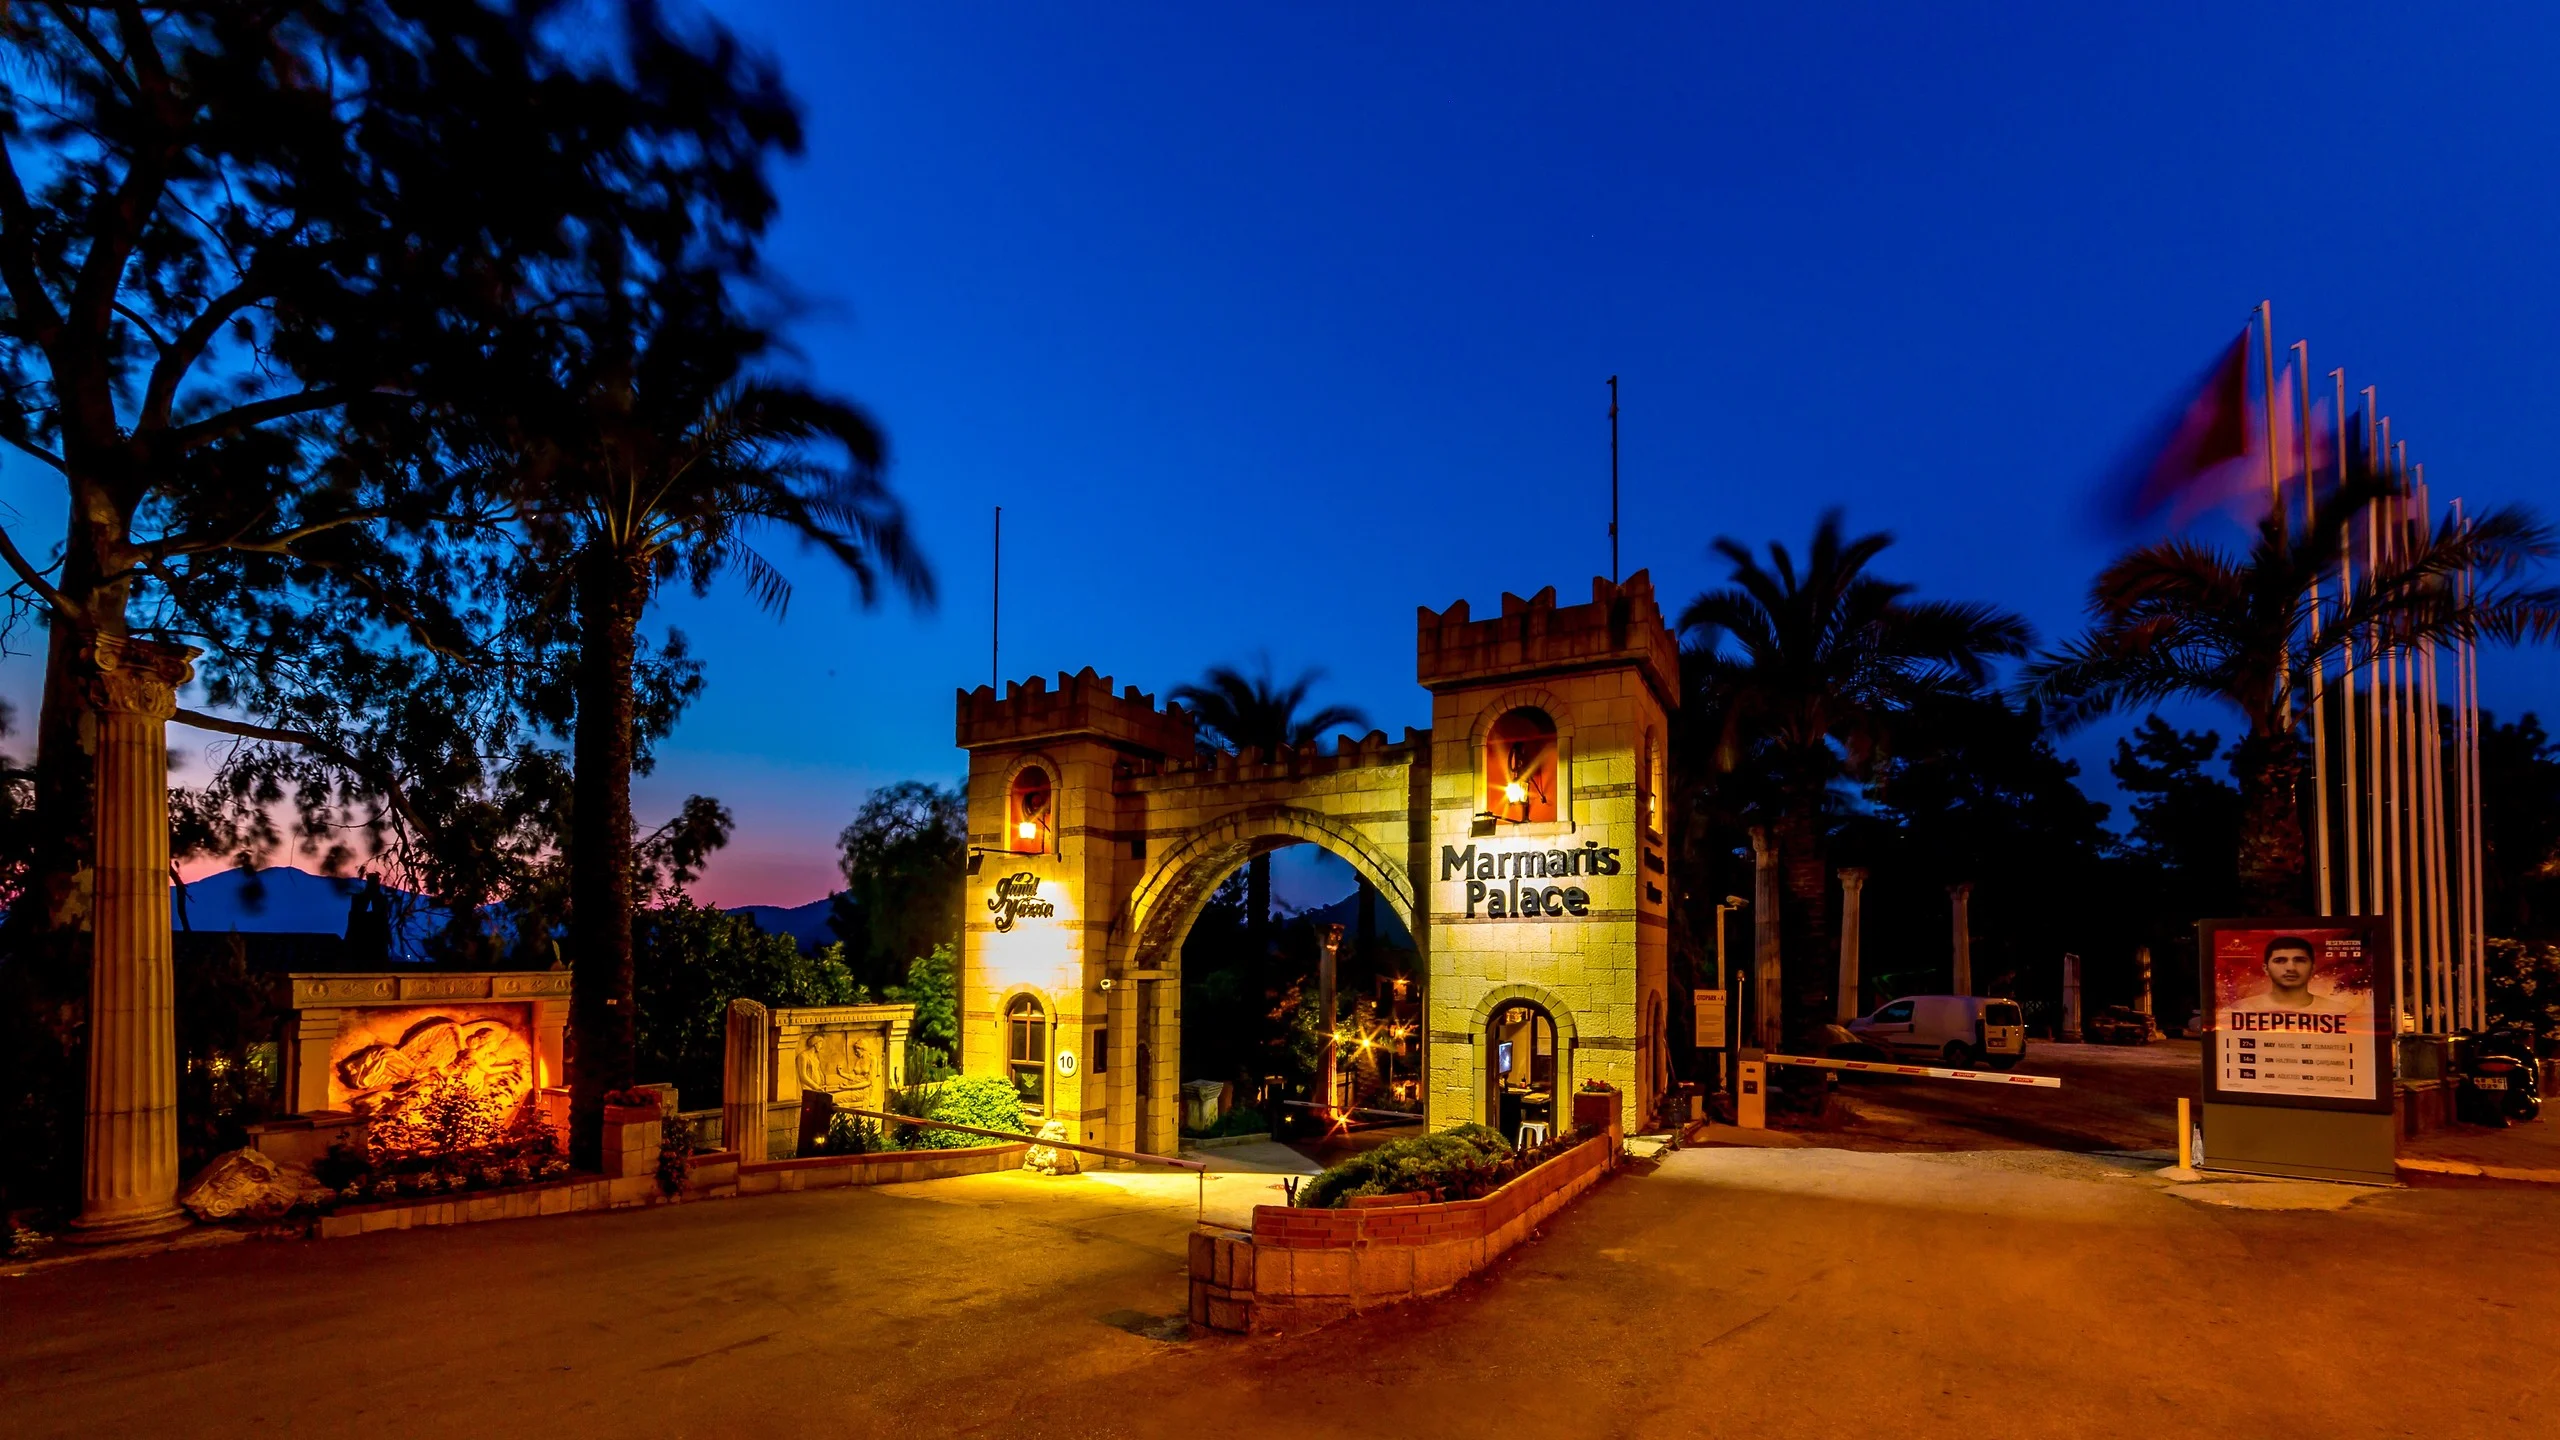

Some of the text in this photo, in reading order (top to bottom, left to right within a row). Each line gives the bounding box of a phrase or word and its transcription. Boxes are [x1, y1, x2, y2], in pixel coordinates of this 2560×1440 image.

[1441, 841, 1621, 881] Marmaris
[1466, 878, 1590, 919] Palace
[1060, 1056, 1073, 1068] 10
